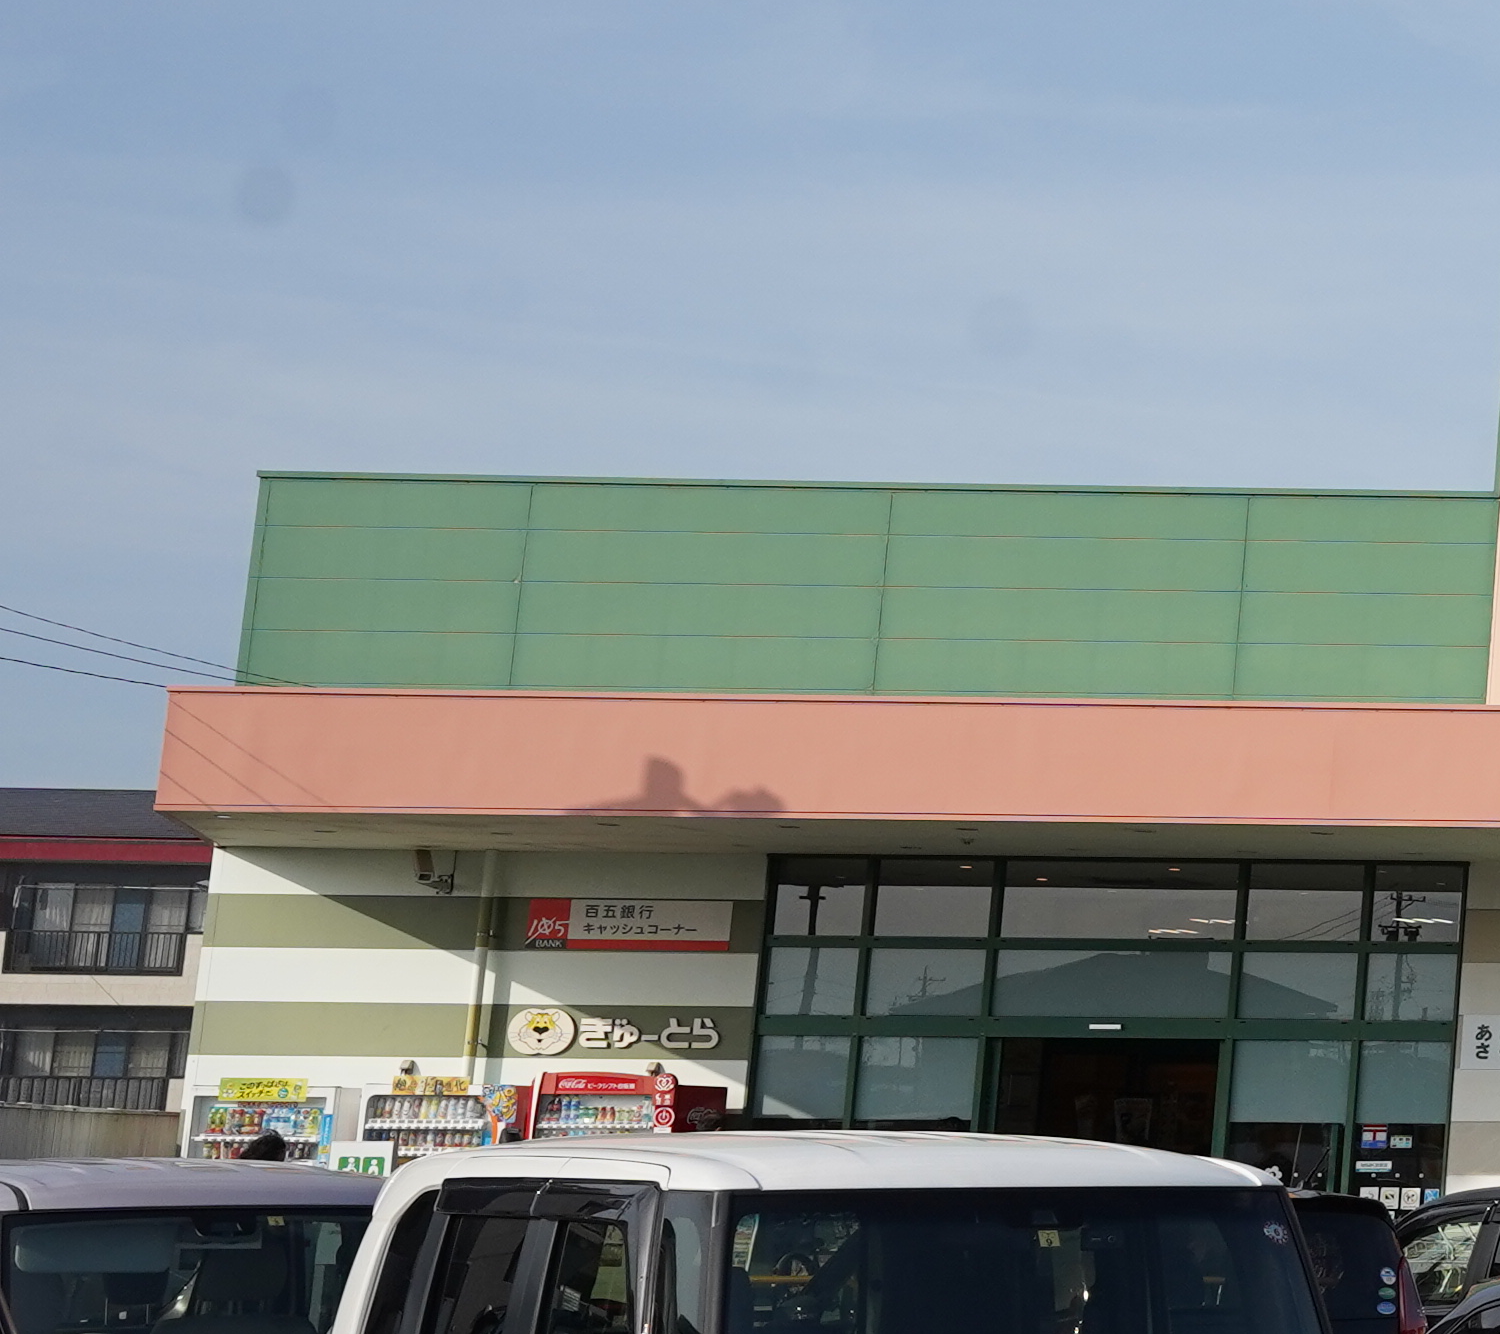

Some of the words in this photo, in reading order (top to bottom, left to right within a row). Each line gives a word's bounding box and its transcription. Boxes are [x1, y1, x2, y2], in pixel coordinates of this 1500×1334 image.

[584, 903, 655, 921] 百五銀行
[582, 922, 699, 937] キャッシュコーナー
[534, 938, 563, 949] BANK
[579, 1017, 721, 1050] ぎゅーとら
